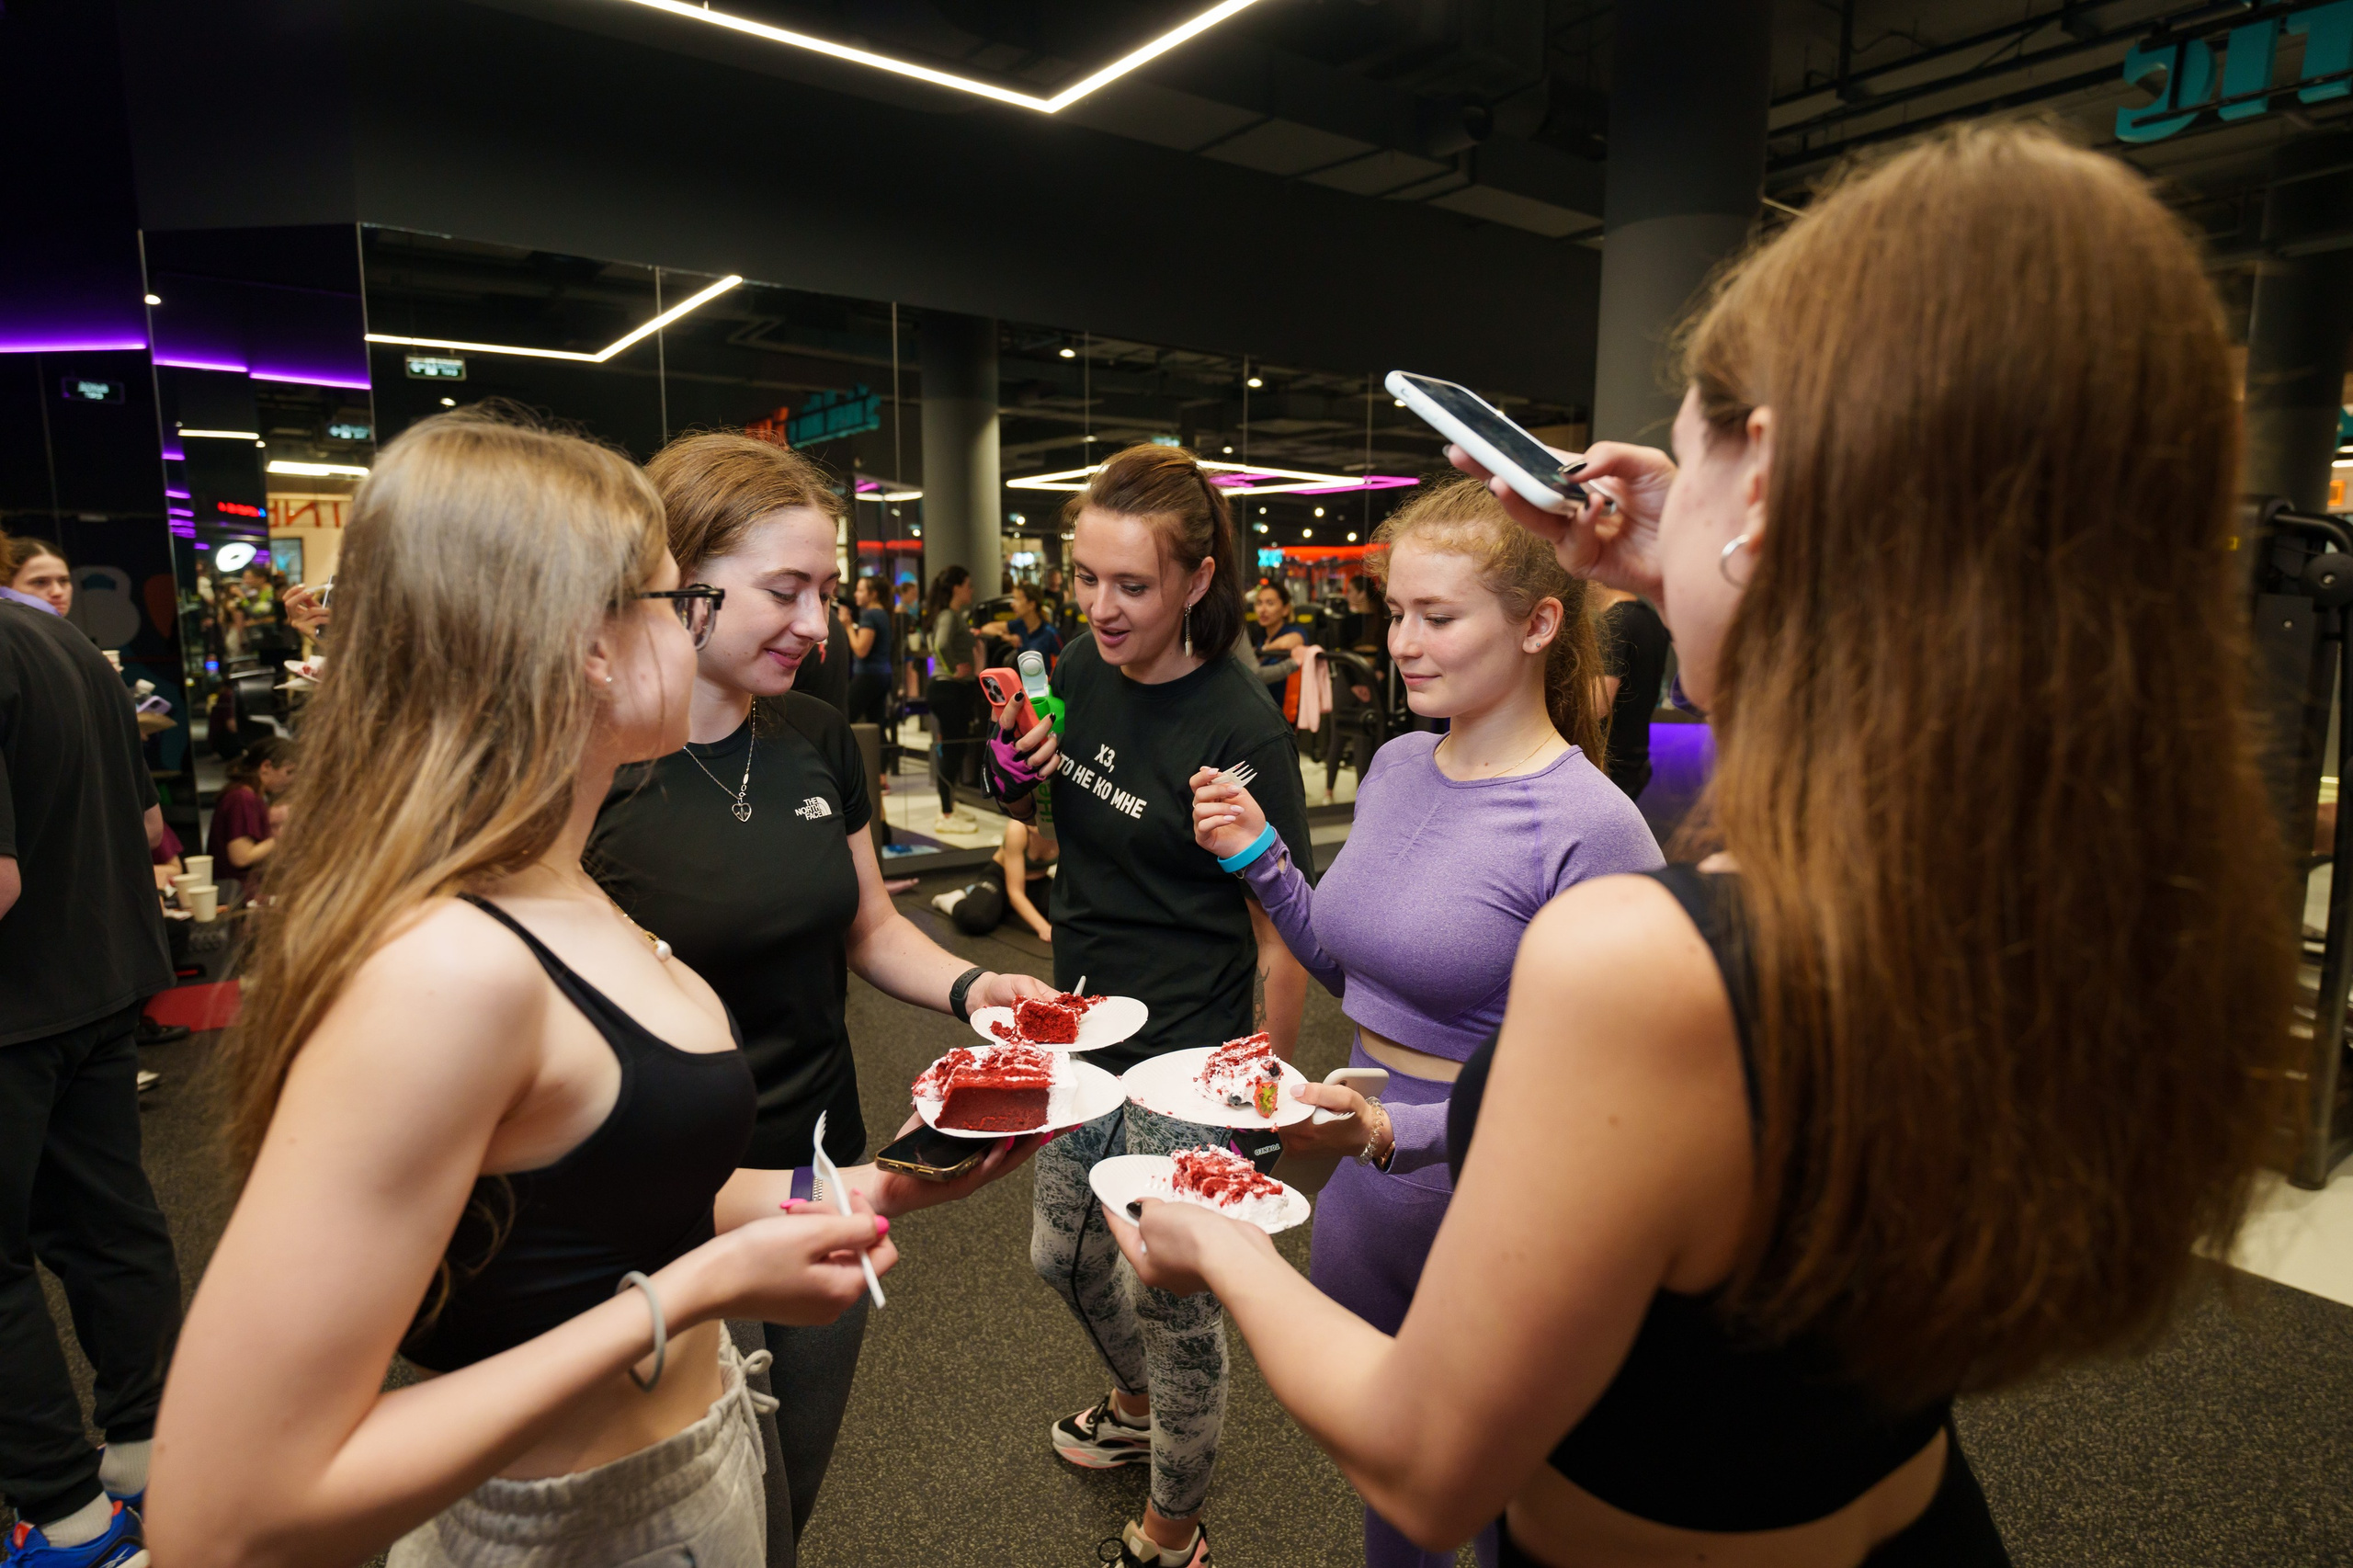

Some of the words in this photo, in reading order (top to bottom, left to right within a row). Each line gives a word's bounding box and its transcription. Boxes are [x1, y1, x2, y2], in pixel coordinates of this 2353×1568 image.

[1056, 750, 1074, 776] ТО
[1072, 765, 1095, 789] НЕ
[1092, 776, 1112, 800] КО
[1110, 788, 1147, 819] МНЕ
[803, 797, 818, 806] THE
[794, 803, 820, 816] NORTH
[805, 811, 823, 821] FACE
